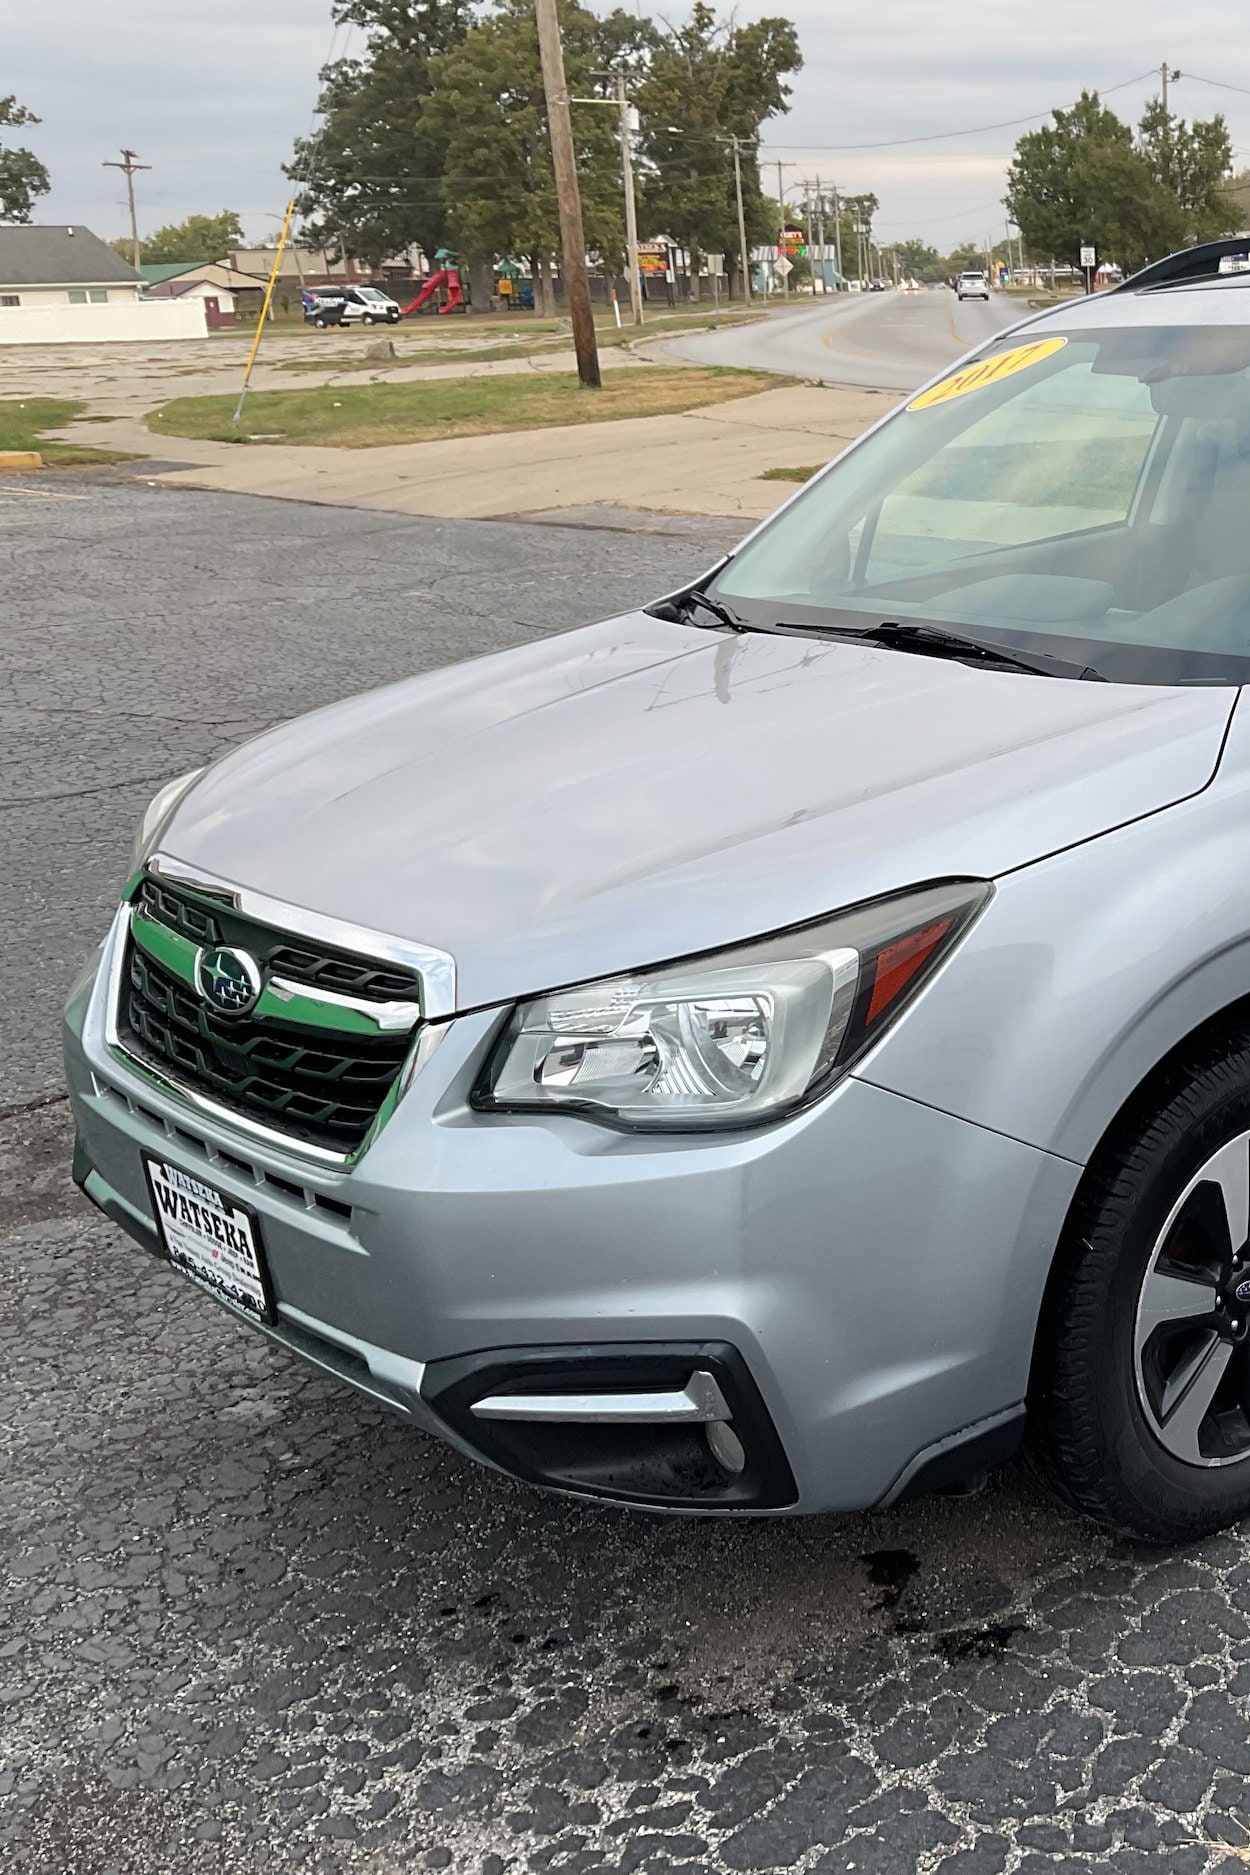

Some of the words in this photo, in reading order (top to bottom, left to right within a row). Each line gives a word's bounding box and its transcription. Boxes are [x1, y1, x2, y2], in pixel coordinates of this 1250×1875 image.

[930, 342, 1044, 404] 2017
[163, 1162, 225, 1208] WATSEKA
[154, 1180, 253, 1260] WATSEKA
